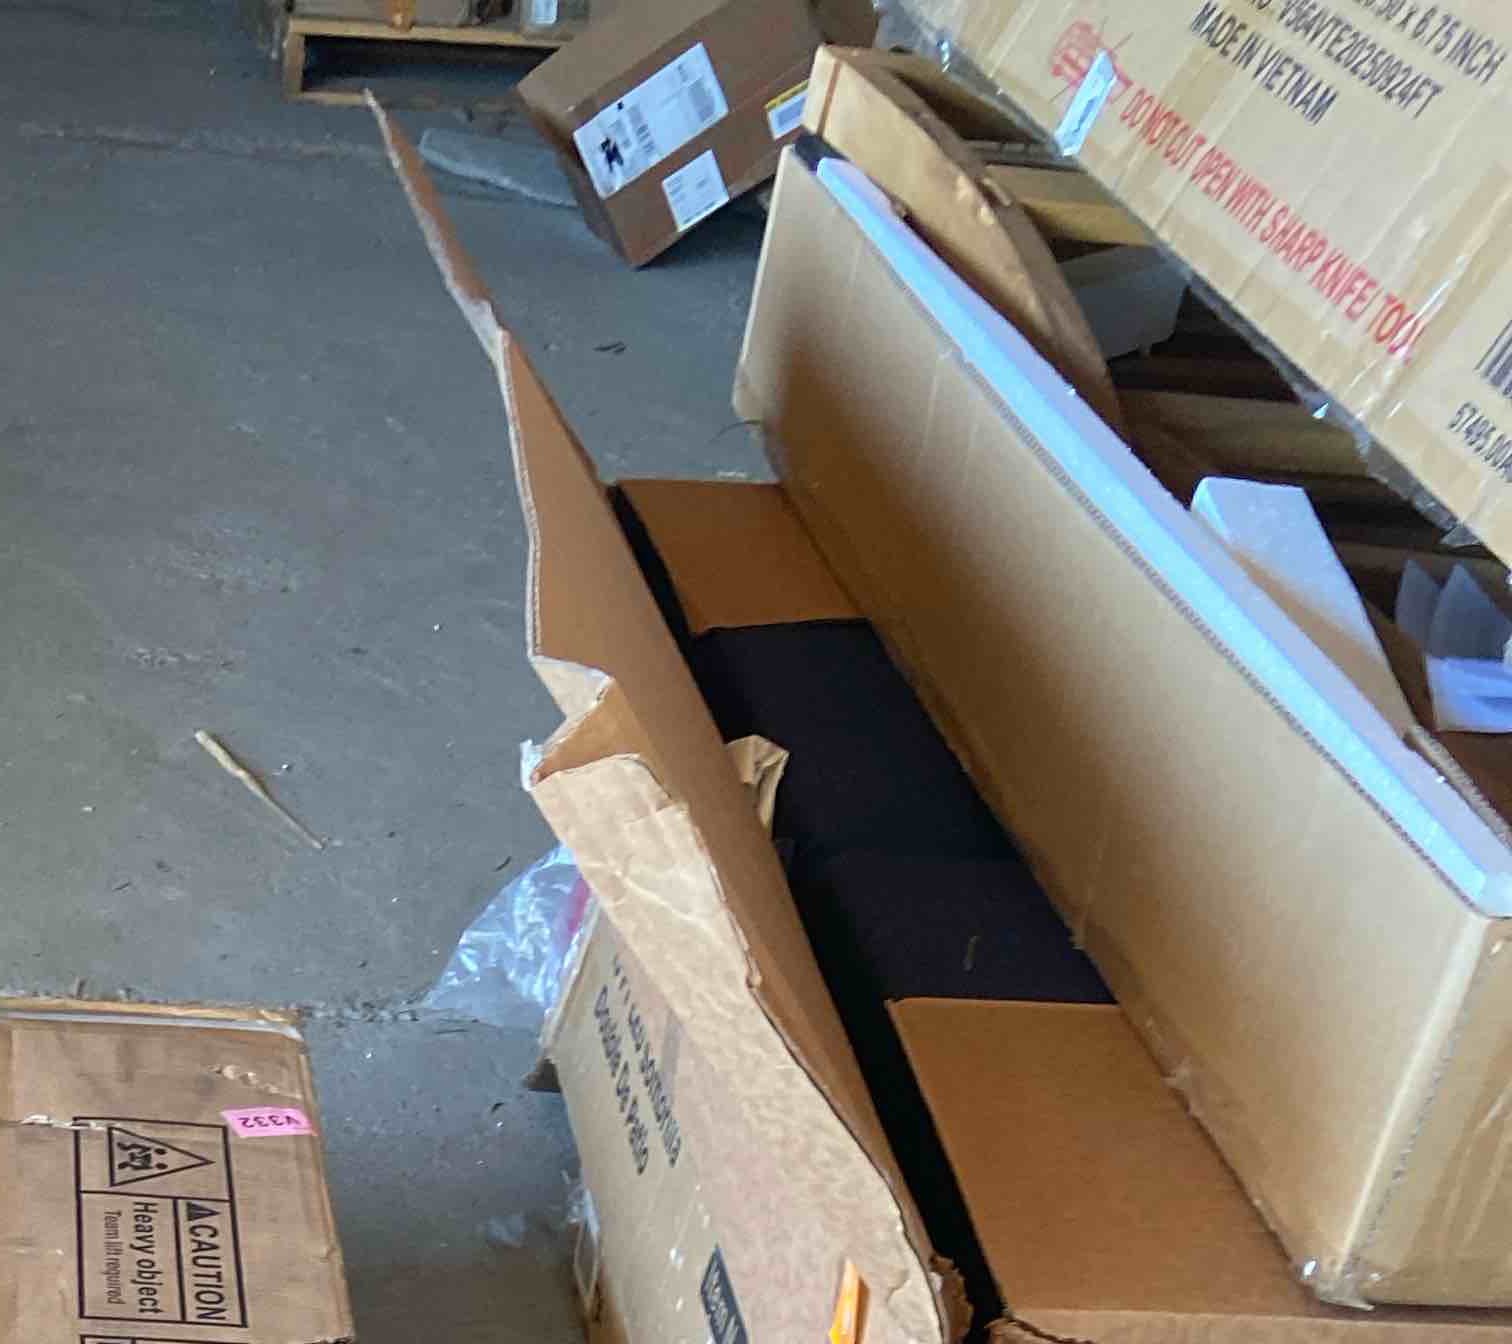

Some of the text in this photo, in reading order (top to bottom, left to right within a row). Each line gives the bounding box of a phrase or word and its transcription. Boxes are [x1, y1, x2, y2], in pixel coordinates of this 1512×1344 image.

[1190, 0, 1340, 126] MADE IN VIETNAM
[1443, 28, 1507, 86] INCH
[1120, 87, 1154, 128] DO
[1140, 100, 1184, 147] NOT
[1162, 122, 1206, 172] CUT
[1190, 143, 1241, 204] OPEN
[1224, 169, 1273, 236] WITH
[1259, 202, 1328, 274] SHARP
[100, 1209, 127, 1306] Team lift required
[129, 1200, 164, 1314] Heavy object
[187, 1223, 228, 1321] CAUTION
